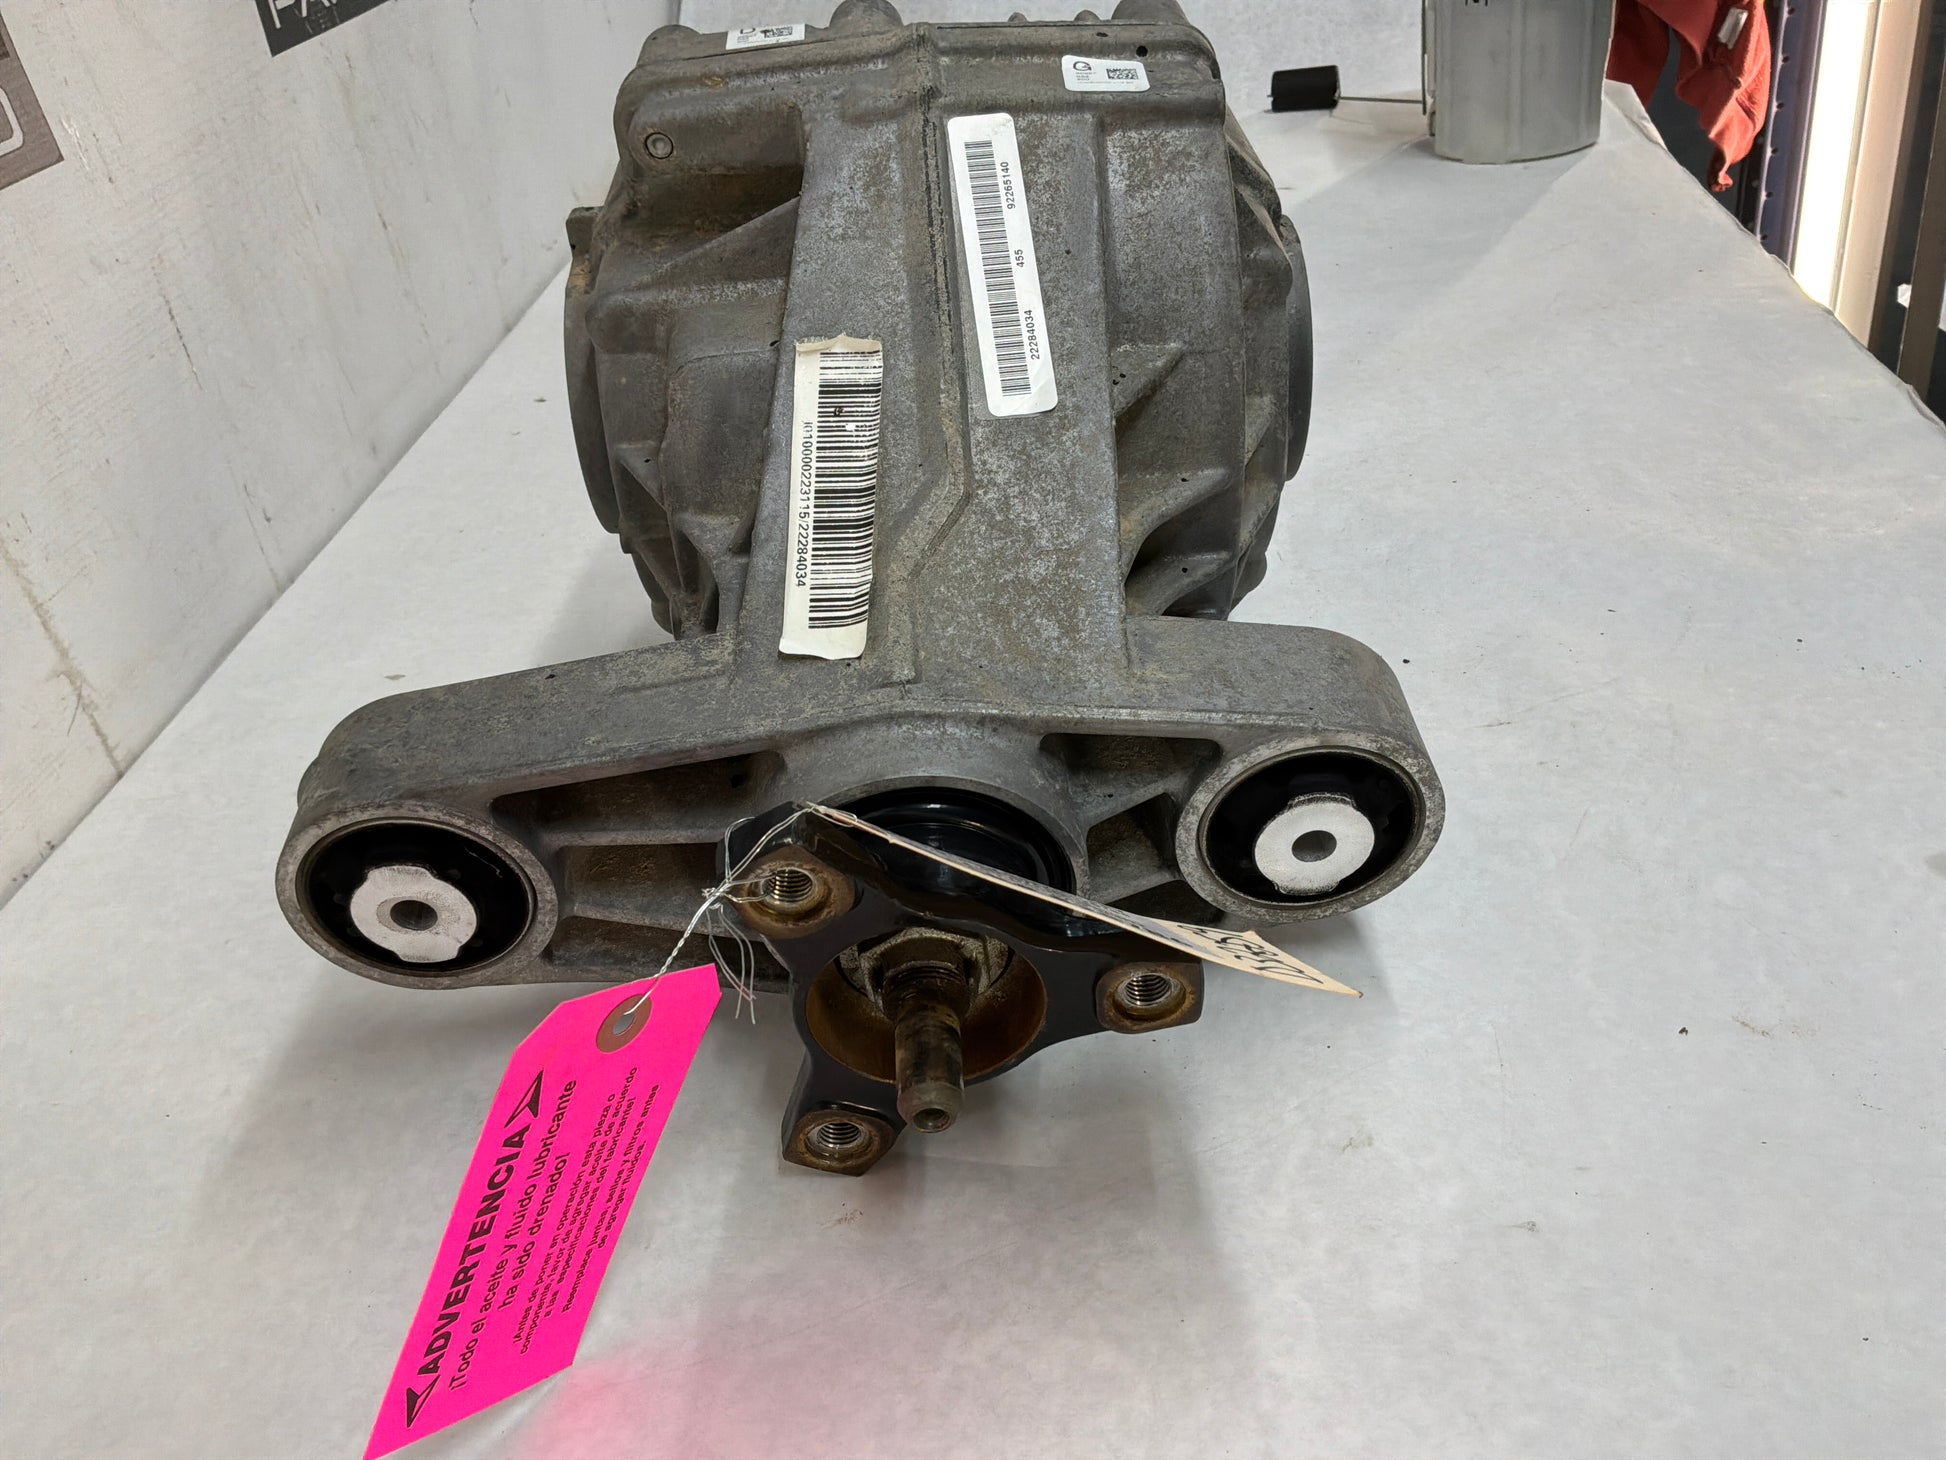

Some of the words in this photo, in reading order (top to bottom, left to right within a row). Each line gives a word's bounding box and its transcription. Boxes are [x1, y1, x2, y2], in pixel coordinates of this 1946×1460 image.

[1000, 161, 1016, 210] 92265140
[1015, 249, 1025, 268] 455
[1024, 309, 1041, 360] 22284034
[640, 1084, 660, 1118] antes
[526, 1080, 577, 1180] lubricante
[602, 1097, 636, 1164] fabricante!
[623, 1120, 645, 1157] filtros
[596, 1165, 609, 1184] del
[605, 1168, 625, 1204] sellos
[620, 1159, 631, 1167] y
[504, 1183, 538, 1240] fluido
[520, 1279, 555, 1355] componente,
[546, 1247, 566, 1278] favor
[561, 1228, 573, 1244] de
[568, 1181, 592, 1227] agregar
[588, 1139, 608, 1177] aceite
[604, 1121, 616, 1137] de
[611, 1067, 638, 1119] acuerdo
[527, 1287, 540, 1304] de
[535, 1252, 553, 1286] poner
[549, 1233, 561, 1249] en
[556, 1170, 586, 1231] operación
[581, 1140, 597, 1168] esta
[592, 1104, 612, 1139] pieza
[607, 1093, 616, 1103] o
[597, 1234, 609, 1249] de
[604, 1188, 627, 1232] agregar
[621, 1140, 647, 1186] fluidos.
[417, 1124, 531, 1376] ADVERTENCIA
[497, 1284, 519, 1310] ha
[511, 1240, 536, 1281] sido
[527, 1152, 570, 1236] drenado!
[501, 1243, 518, 1256] y
[556, 1186, 600, 1285] especificaciones
[587, 1205, 611, 1247] juntas,
[479, 1258, 509, 1314] aceite
[545, 1289, 560, 1309] las
[561, 1248, 593, 1313] Reemplace
[471, 1316, 487, 1335] el
[543, 1309, 553, 1318] a
[448, 1337, 479, 1391] ¡Todo
